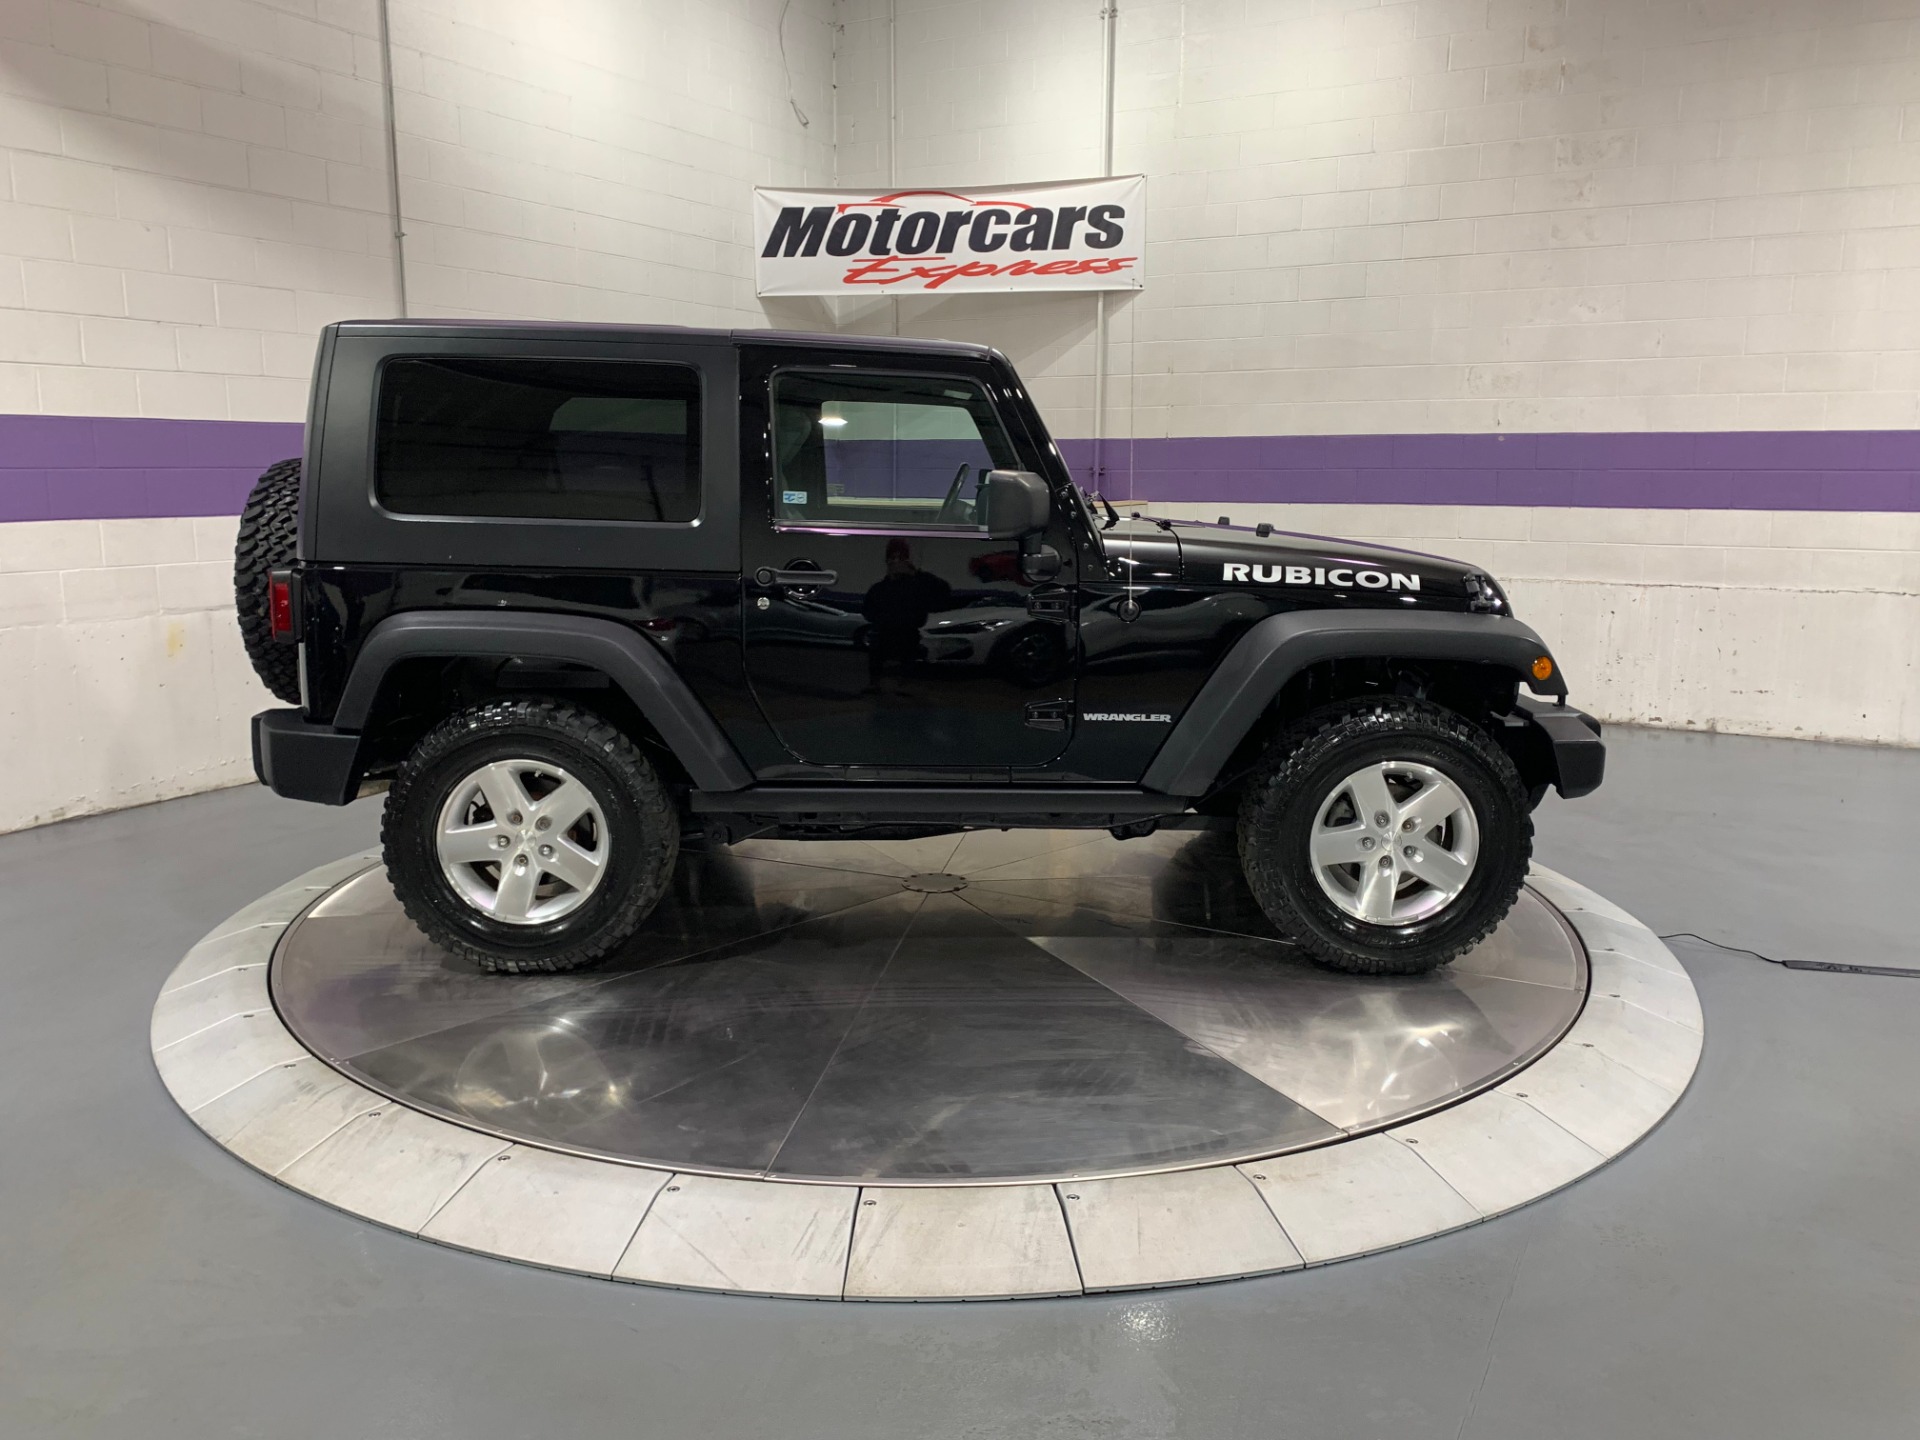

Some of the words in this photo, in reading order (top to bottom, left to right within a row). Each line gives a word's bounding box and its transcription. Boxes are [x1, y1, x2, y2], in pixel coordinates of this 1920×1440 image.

[761, 204, 1125, 258] Motorcars
[842, 255, 1139, 289] Express
[1222, 562, 1421, 591] RUBICON
[1083, 713, 1171, 722] WRANGLER
